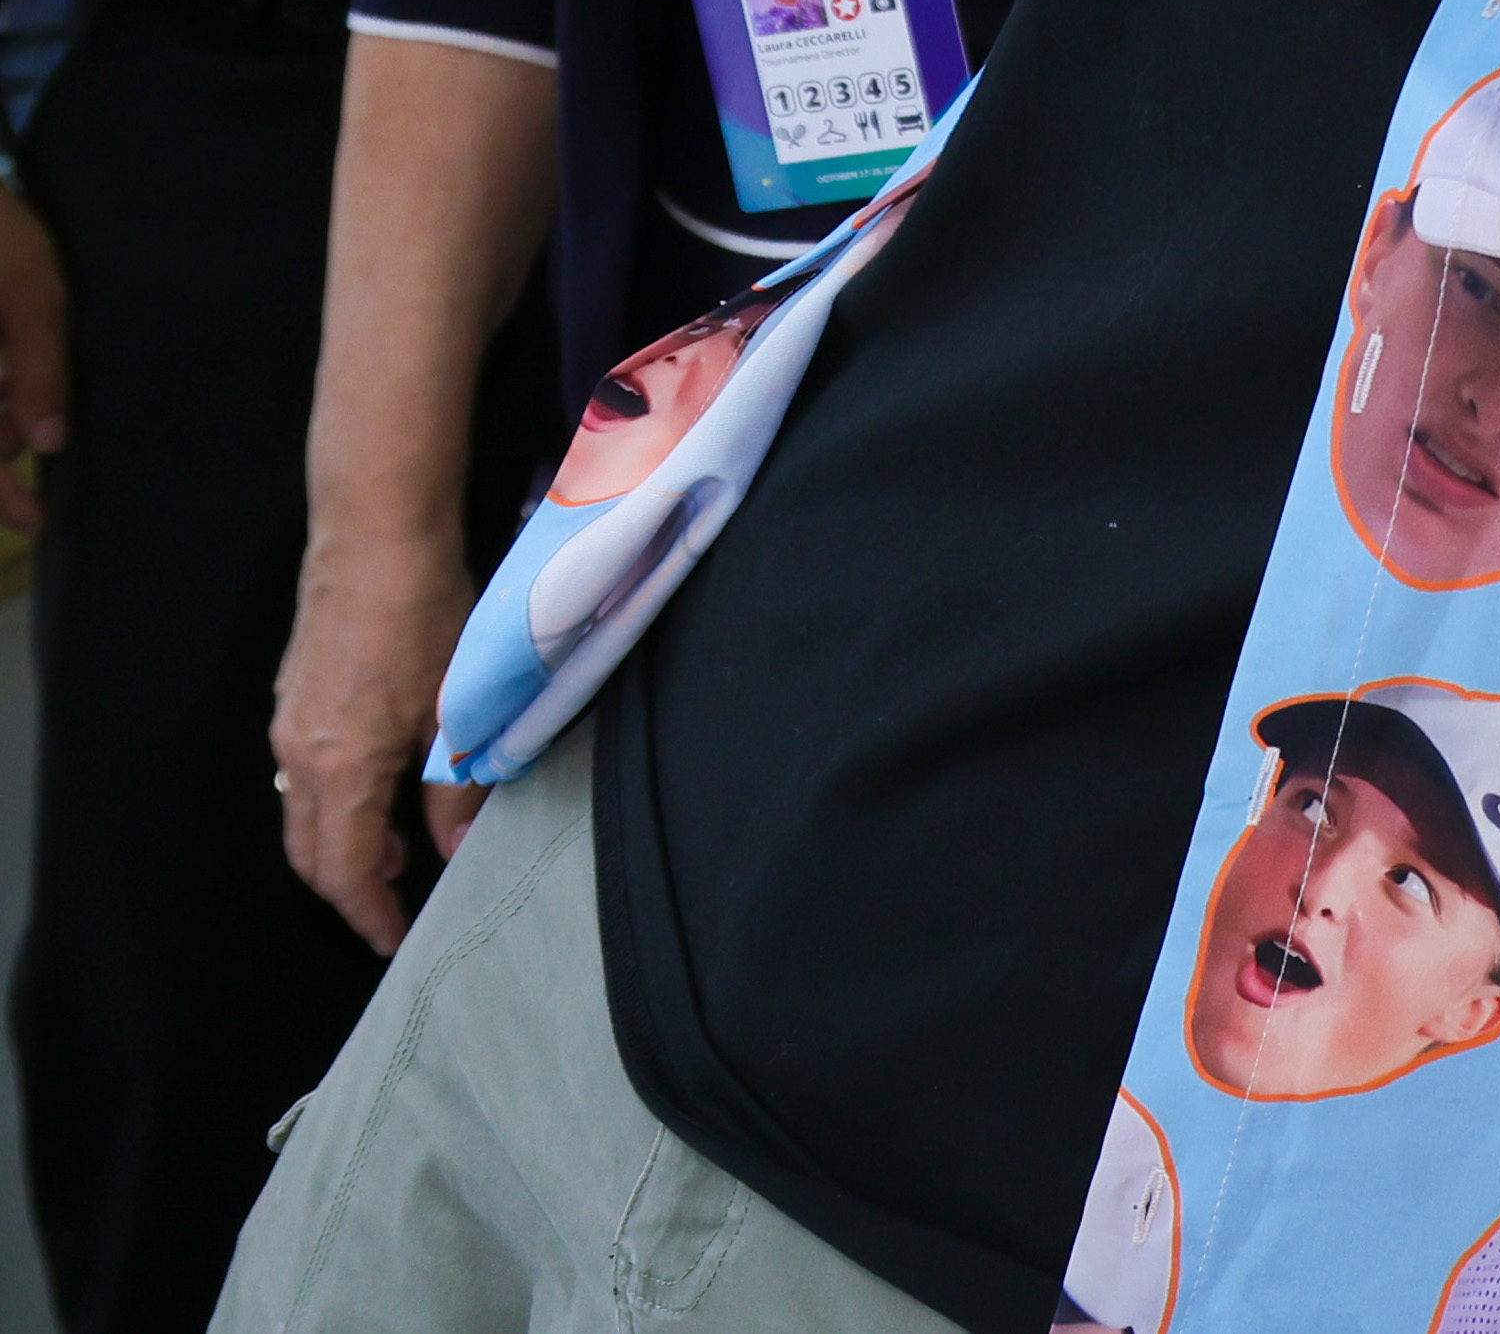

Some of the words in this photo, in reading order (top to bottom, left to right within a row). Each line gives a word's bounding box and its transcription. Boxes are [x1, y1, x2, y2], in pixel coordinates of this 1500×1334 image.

[757, 40, 793, 53] Laura
[795, 28, 867, 48] CECCARELLI
[774, 90, 789, 111] 1
[803, 86, 821, 107] 2
[834, 82, 851, 103] 3
[864, 77, 882, 99] 4
[896, 73, 912, 95] 5
